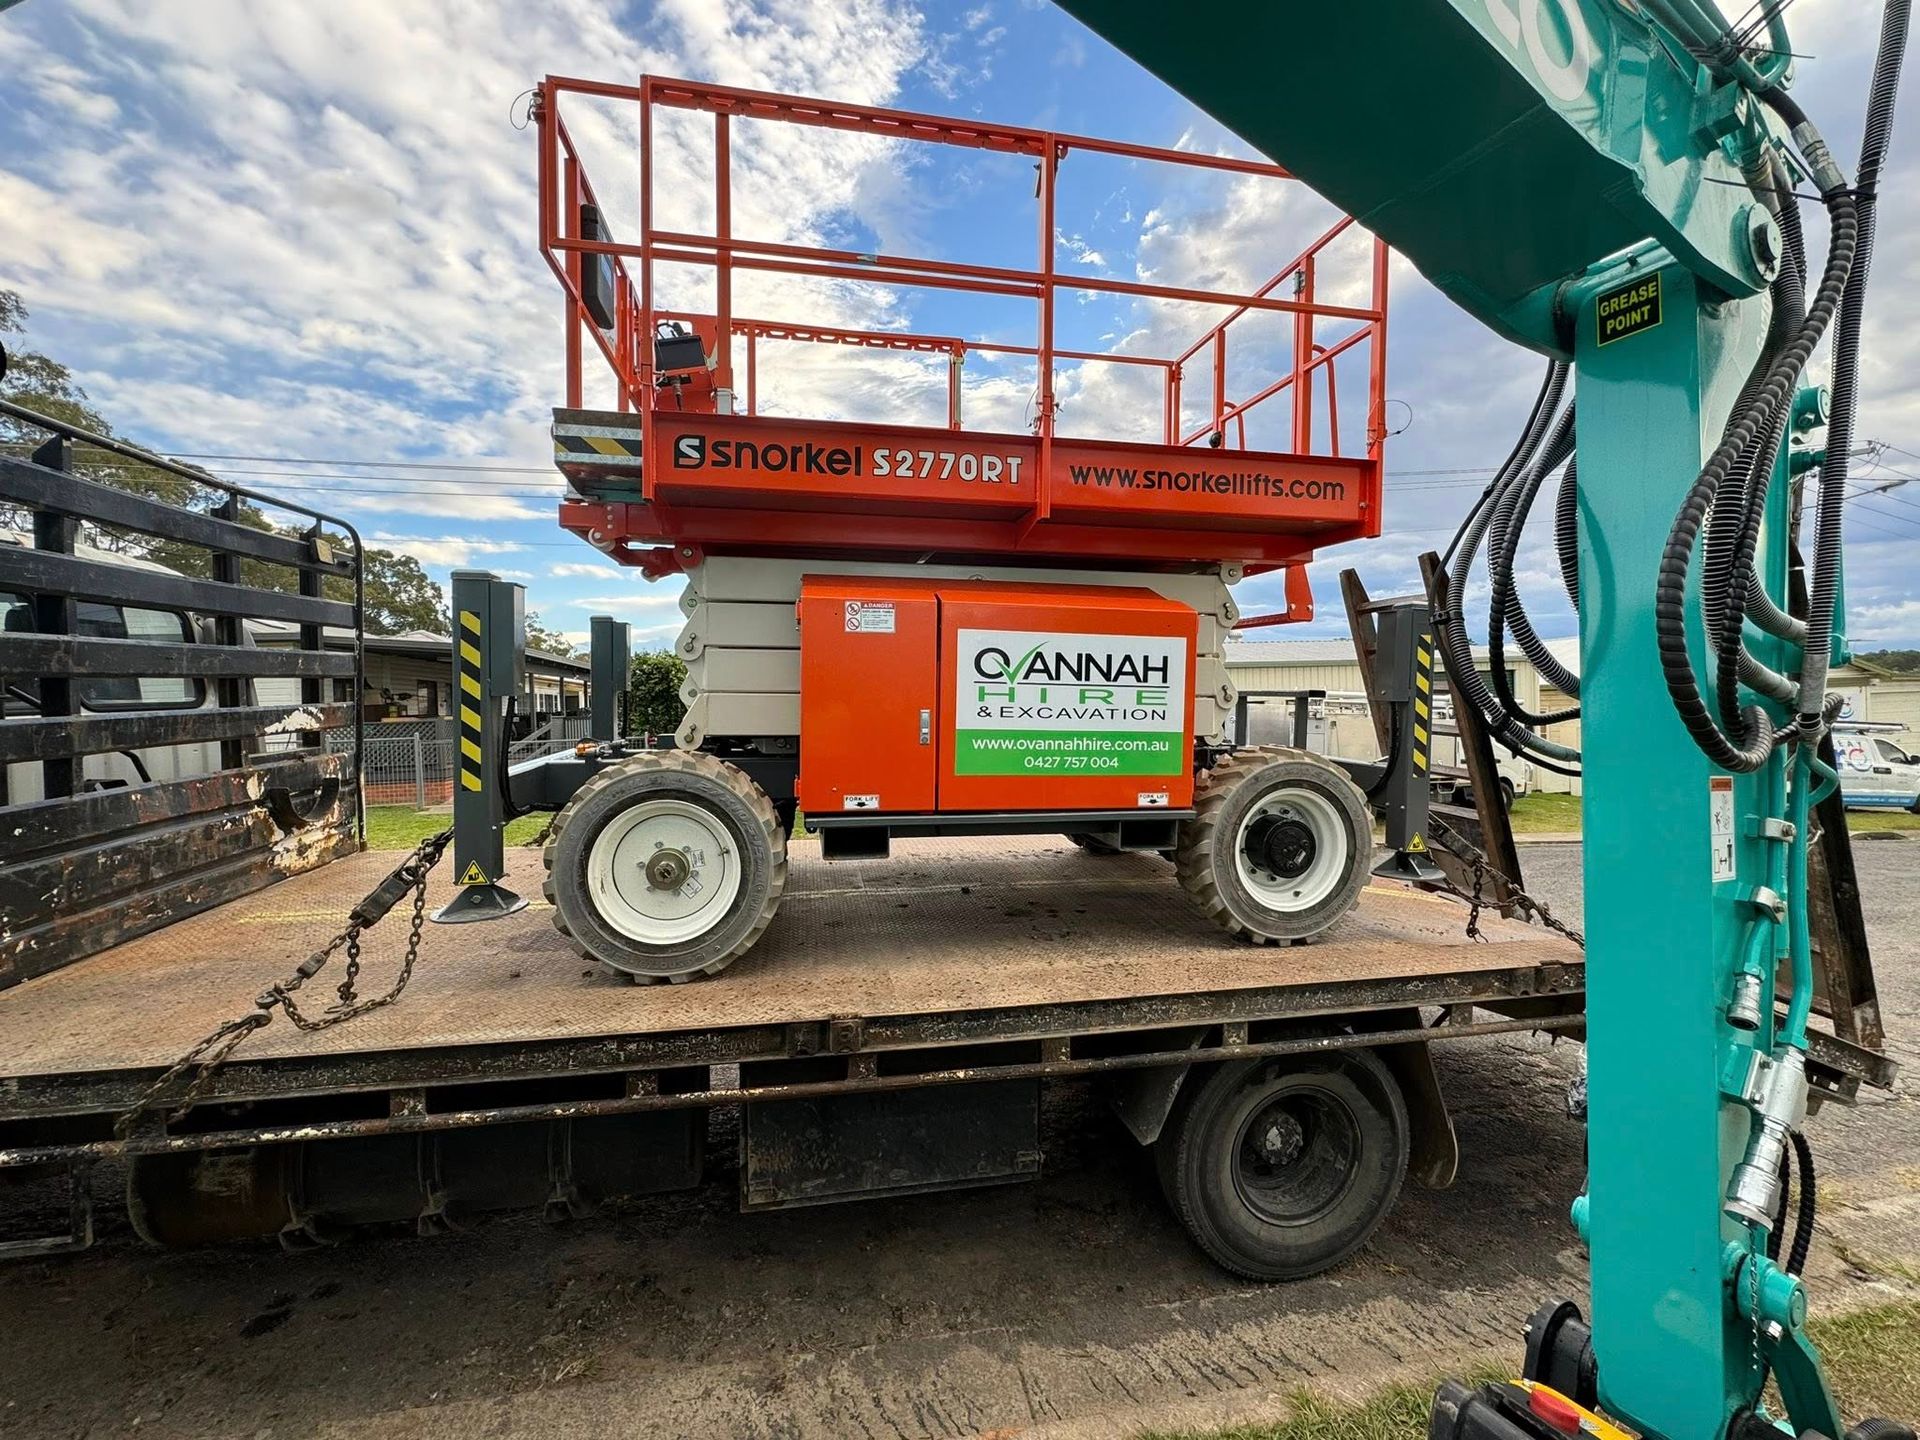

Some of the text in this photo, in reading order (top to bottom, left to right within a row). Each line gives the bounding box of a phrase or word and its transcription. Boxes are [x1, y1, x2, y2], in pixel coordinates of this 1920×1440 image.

[1599, 281, 1658, 317] GREASE
[1606, 304, 1651, 335] POINT
[711, 440, 862, 476] snorkel
[872, 448, 1023, 484] S2770RT
[1069, 465, 1345, 501] www.snorkellifts.com
[978, 685, 1168, 706] HIRE
[977, 705, 1166, 721] & EXCAVATION
[972, 737, 1169, 752] www.ovannahhire.com.au
[1024, 756, 1119, 769] 0427 757 004
